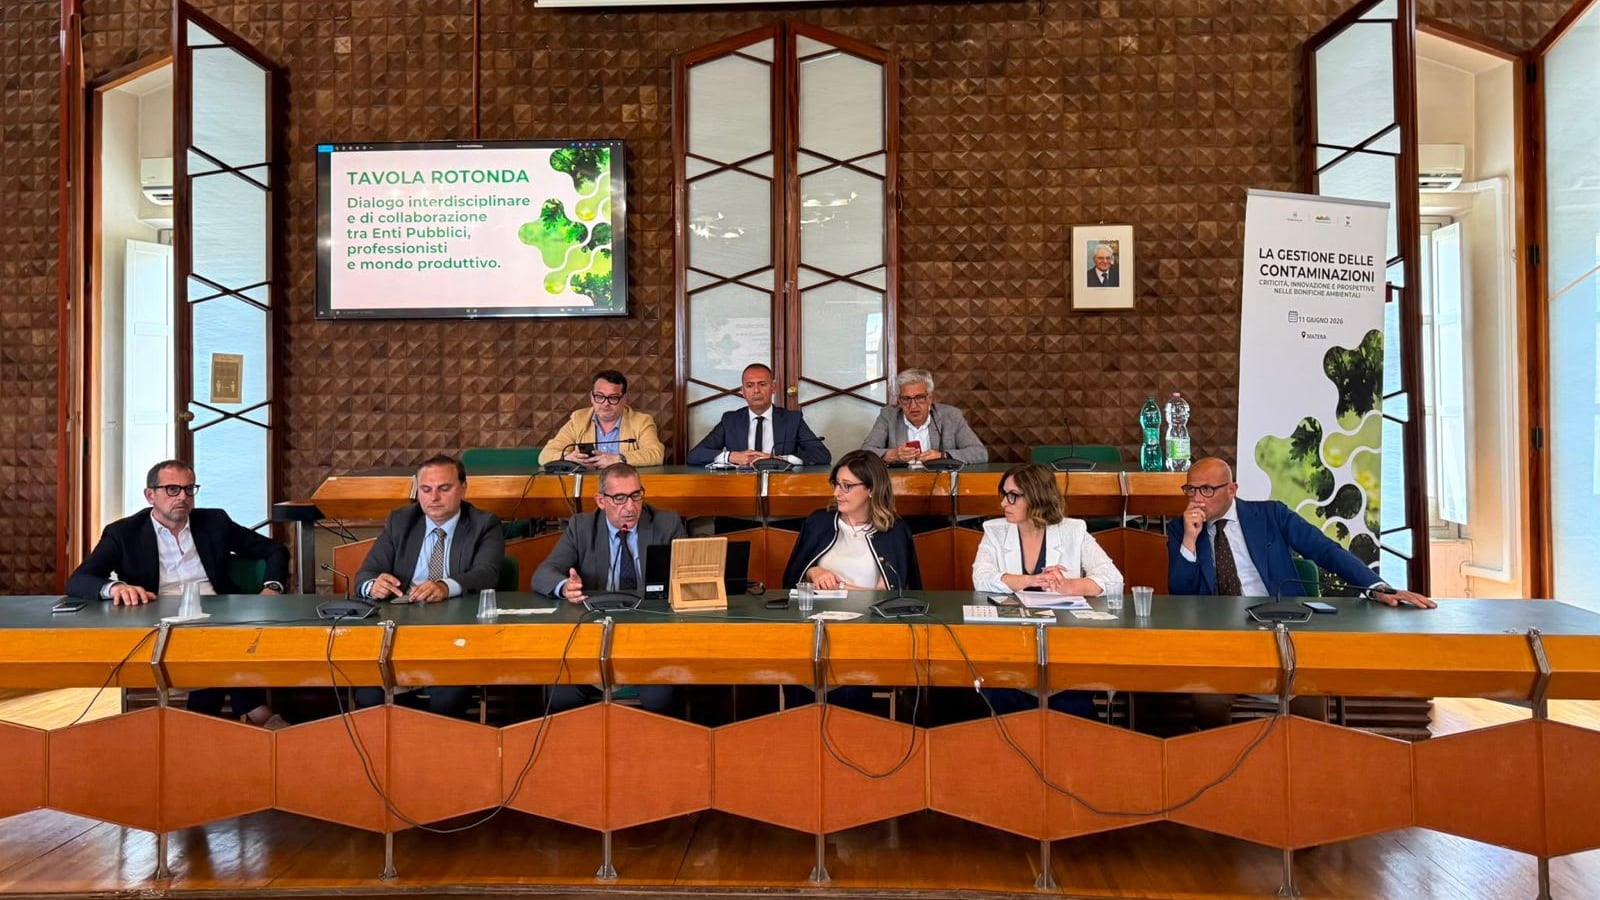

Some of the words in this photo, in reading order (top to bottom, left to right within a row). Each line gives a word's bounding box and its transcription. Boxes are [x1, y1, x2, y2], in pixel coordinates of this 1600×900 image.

[347, 170, 425, 185] TAVOLA
[431, 168, 530, 184] ROTONDA
[347, 196, 404, 211] Dialogo
[408, 195, 530, 209] interdisciplinare
[347, 214, 356, 224] e
[359, 211, 373, 224] di
[378, 211, 487, 223] collaborazione
[347, 228, 367, 239] tra
[372, 226, 401, 239] Enti
[406, 226, 471, 240] Pubblici,
[347, 242, 447, 257] professionisti
[1259, 247, 1274, 260] LA
[1277, 249, 1335, 264] GESTIONE
[1338, 253, 1374, 266] DELLE
[347, 260, 356, 270] e
[360, 257, 413, 270] mondo
[418, 256, 501, 272] produttivo.
[1260, 264, 1375, 283] CONTAMINAZIONI
[1259, 279, 1290, 287] CRITICITÀ,
[1290, 281, 1331, 290] INNOVAZIONE
[1336, 284, 1375, 292] PROSPETTIVE
[1293, 289, 1325, 297] BONIFICHE
